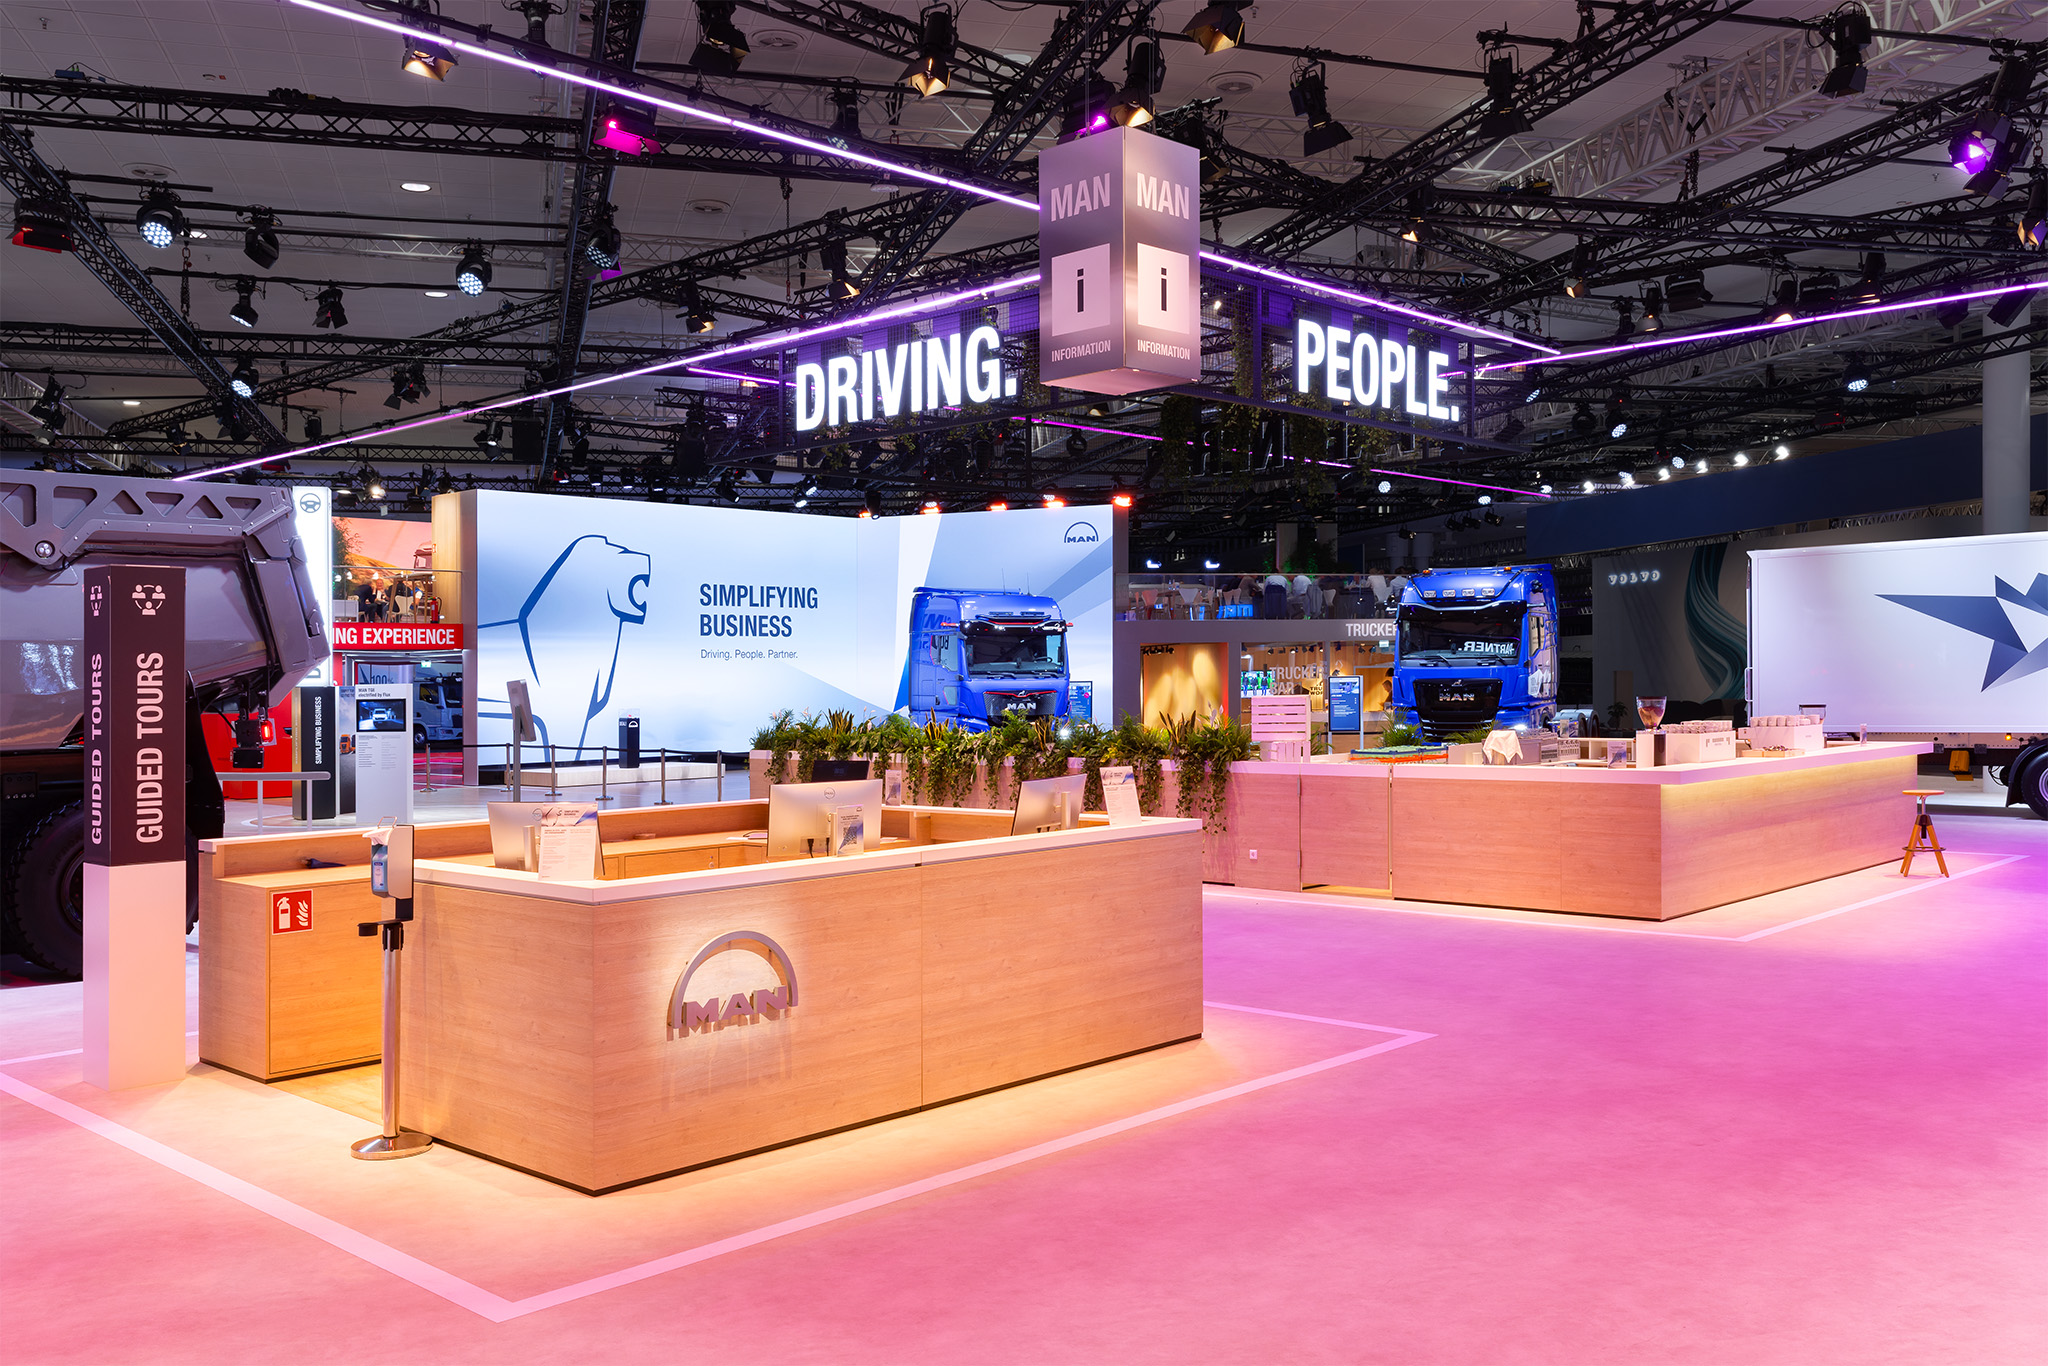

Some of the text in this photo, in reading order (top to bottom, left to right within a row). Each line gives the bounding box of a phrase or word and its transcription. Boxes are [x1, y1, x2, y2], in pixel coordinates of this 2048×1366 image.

[1051, 172, 1111, 222] MAN
[1137, 172, 1190, 220] MAN
[1051, 340, 1111, 362] INFORMATION
[1137, 339, 1191, 361] INFORMATION
[796, 325, 1017, 432] DRIVING.
[1298, 318, 1460, 422] PEOPLE.
[1066, 535, 1096, 543] MAN
[1608, 570, 1661, 586] VOLVO
[700, 582, 818, 609] SIMPLIFYING
[362, 627, 455, 645] EXPERIENCE
[700, 613, 793, 637] BUSINESS
[700, 648, 798, 661] Driving. People. Partner.
[1269, 666, 1328, 680] TRUCKER
[1269, 681, 1295, 695] BAR
[1439, 693, 1475, 702] MAN
[1007, 702, 1037, 710] MAN
[91, 653, 103, 845] GUIDED TOURS
[136, 652, 164, 844] GUIDED TOURS
[683, 985, 788, 1027] MAN
